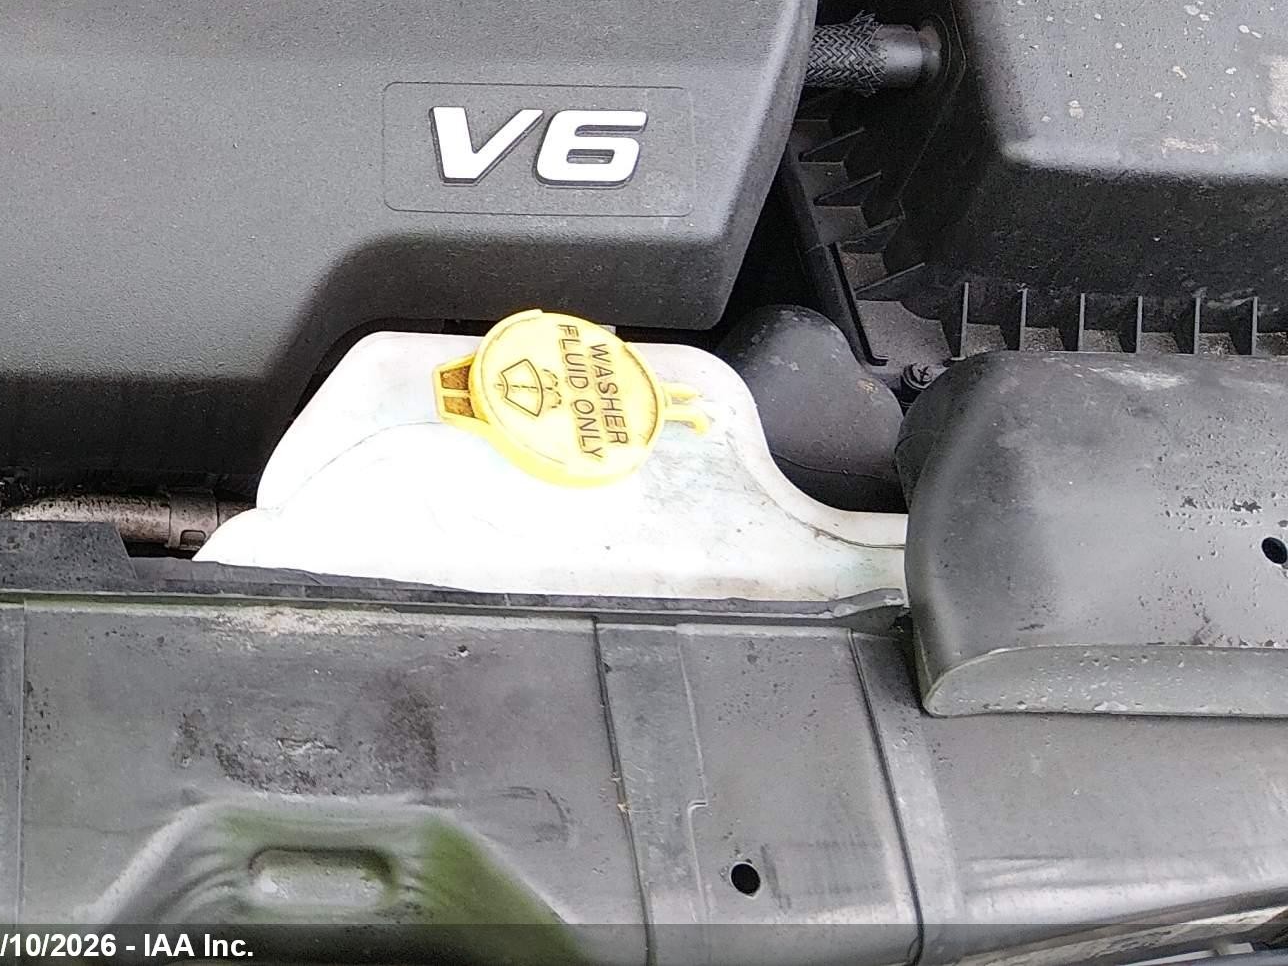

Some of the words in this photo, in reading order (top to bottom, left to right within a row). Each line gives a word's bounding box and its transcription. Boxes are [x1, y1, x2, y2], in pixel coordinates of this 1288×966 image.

[430, 105, 648, 186] V6
[558, 322, 589, 390] FLUID
[572, 397, 604, 459] ONLY
[590, 342, 629, 445] WASHER
